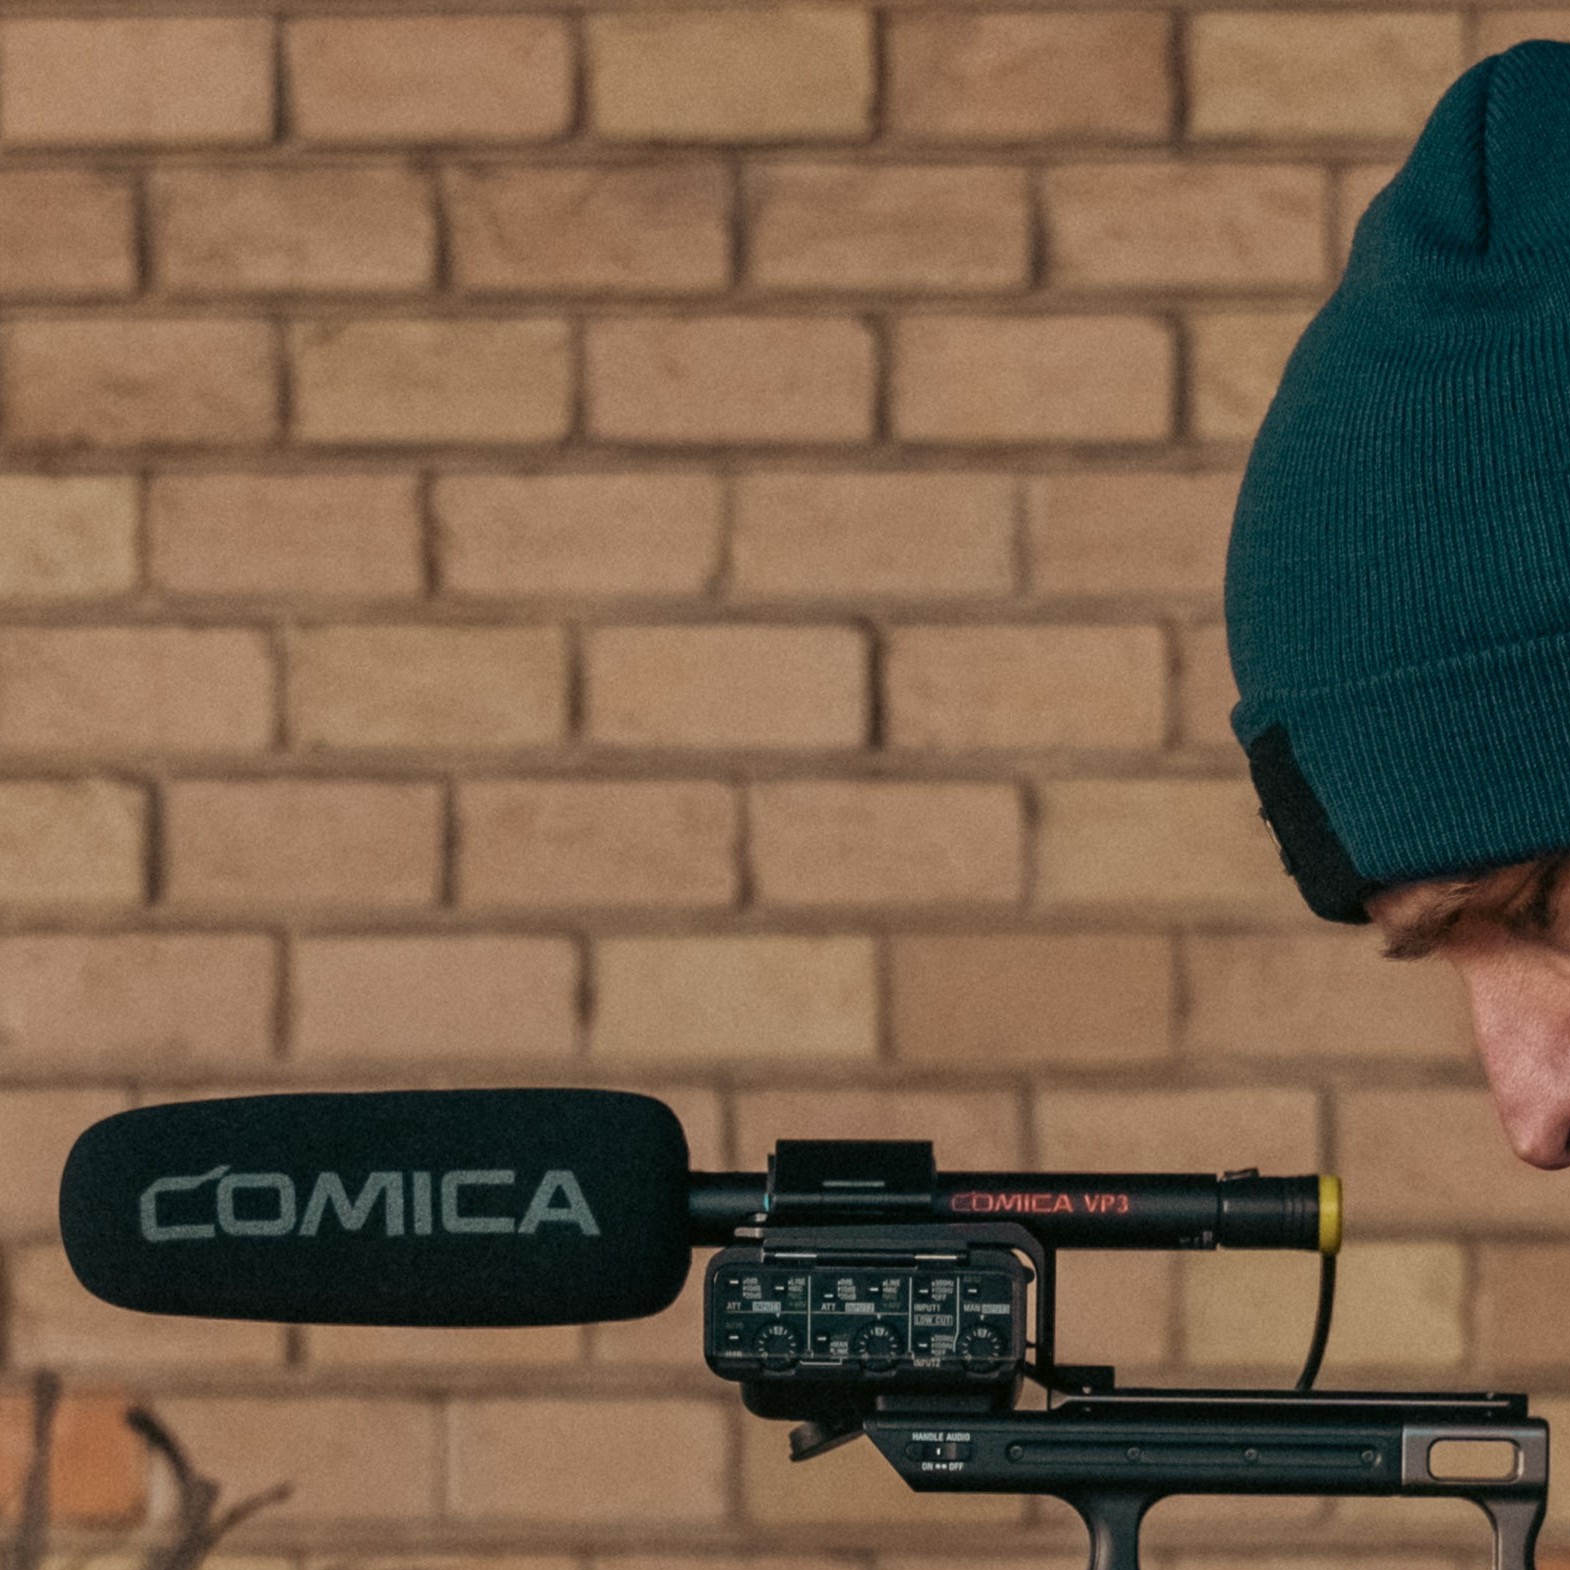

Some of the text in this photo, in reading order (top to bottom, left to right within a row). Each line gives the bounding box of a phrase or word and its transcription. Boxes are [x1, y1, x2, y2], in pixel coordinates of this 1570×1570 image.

[140, 1165, 601, 1243] COMICA
[949, 1191, 1130, 1214] COMICA VP3
[912, 1433, 970, 1442] HANDLE AUDIO
[921, 1462, 933, 1471] ON
